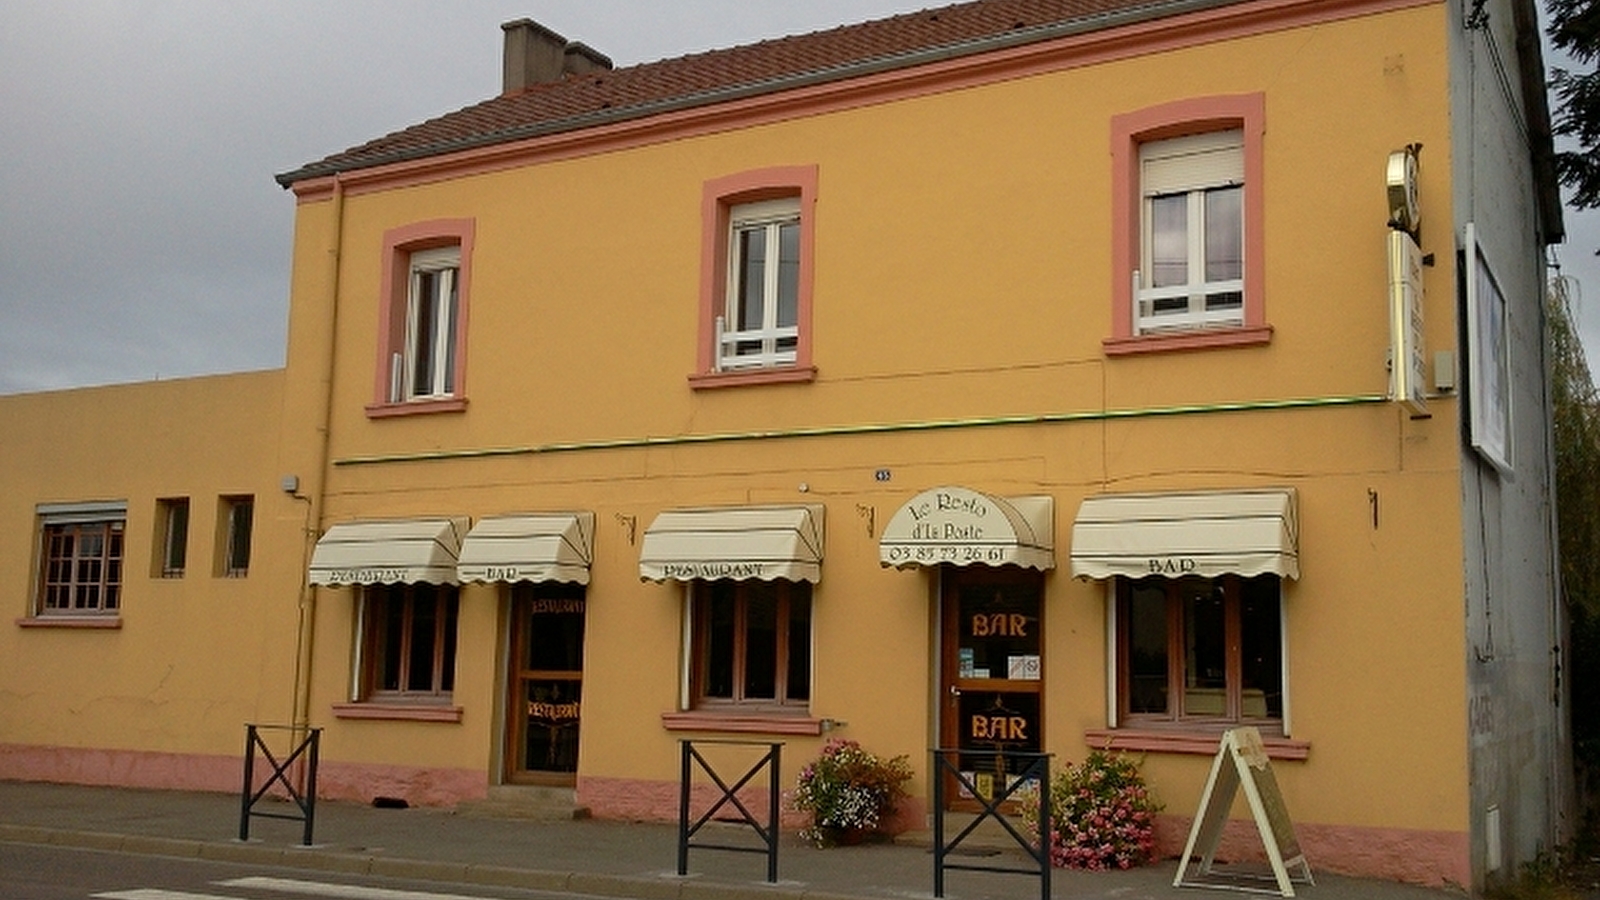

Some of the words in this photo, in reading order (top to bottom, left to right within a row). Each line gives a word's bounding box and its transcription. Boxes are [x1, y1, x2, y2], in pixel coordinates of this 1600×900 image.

[908, 503, 930, 521] Le
[937, 493, 987, 518] Resto
[944, 523, 983, 540] Poste
[889, 547, 911, 560] 03
[916, 547, 934, 560] 85
[940, 547, 957, 560] 73
[963, 547, 982, 560] 26
[988, 547, 1004, 560] 61
[486, 567, 517, 579] BAR
[663, 563, 764, 577] RESTAURANT
[1148, 558, 1196, 573] BAR
[972, 613, 1028, 637] BAR
[971, 714, 1028, 739] BAR
